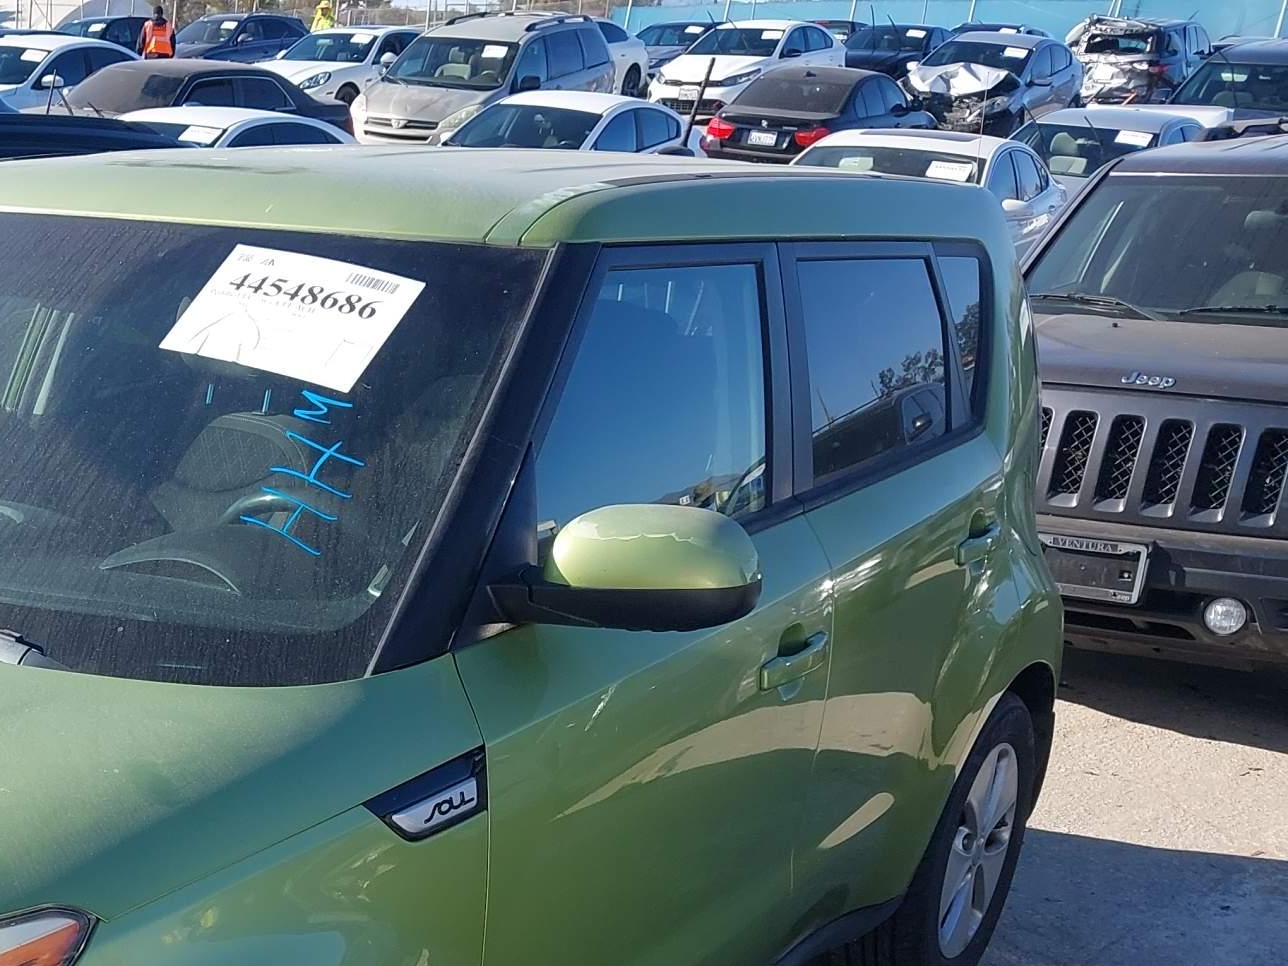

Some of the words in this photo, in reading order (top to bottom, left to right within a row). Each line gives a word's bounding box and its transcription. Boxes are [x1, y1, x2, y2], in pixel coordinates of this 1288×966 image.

[228, 272, 384, 320] 44548686
[1120, 371, 1176, 389] Jeep
[1057, 537, 1113, 553] VENTURA
